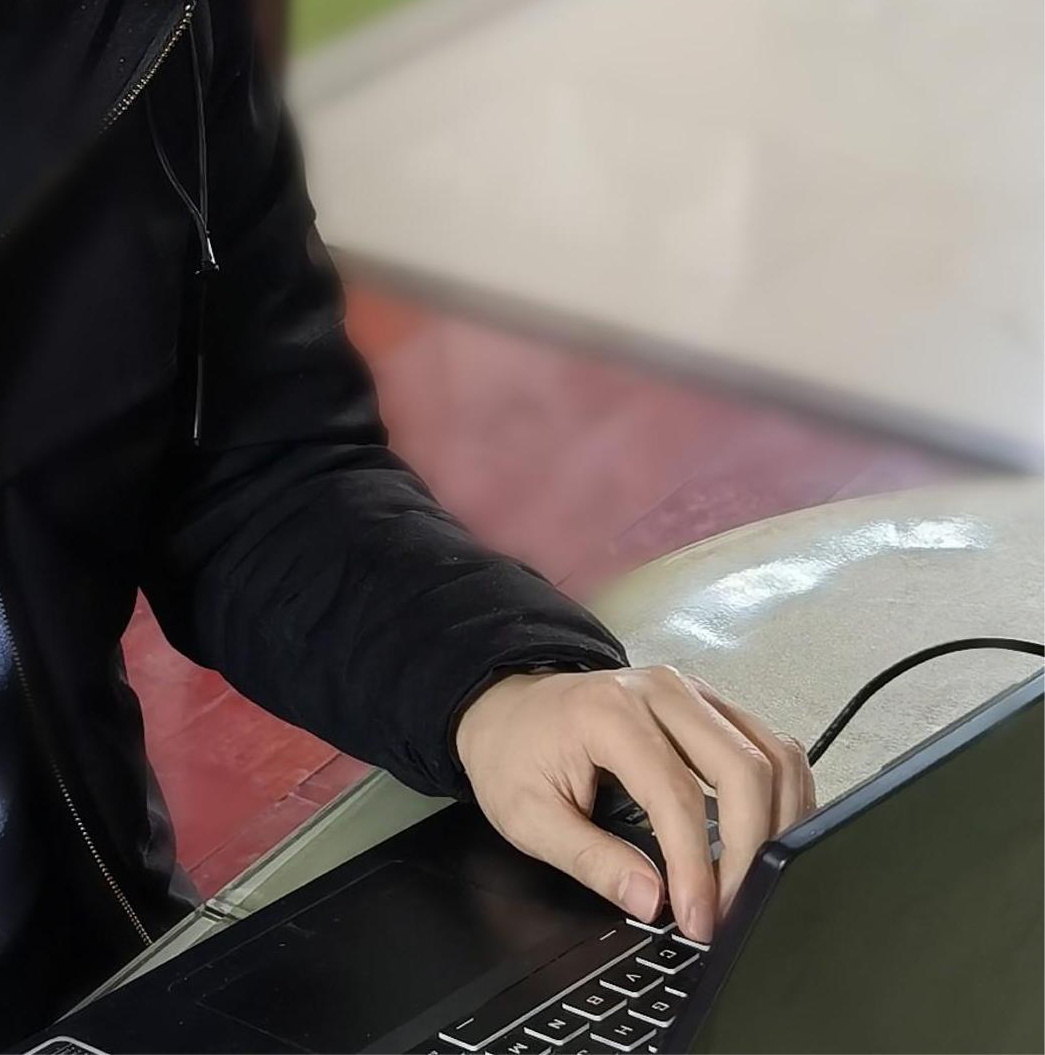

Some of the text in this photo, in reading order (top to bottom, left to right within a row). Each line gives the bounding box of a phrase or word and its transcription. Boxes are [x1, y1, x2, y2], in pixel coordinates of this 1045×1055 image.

[659, 949, 677, 959] C
[625, 973, 642, 983] V
[586, 995, 604, 1005] B
[651, 1001, 670, 1011] G
[547, 1018, 566, 1029] N
[614, 1025, 634, 1036] H
[507, 1042, 528, 1054] M
